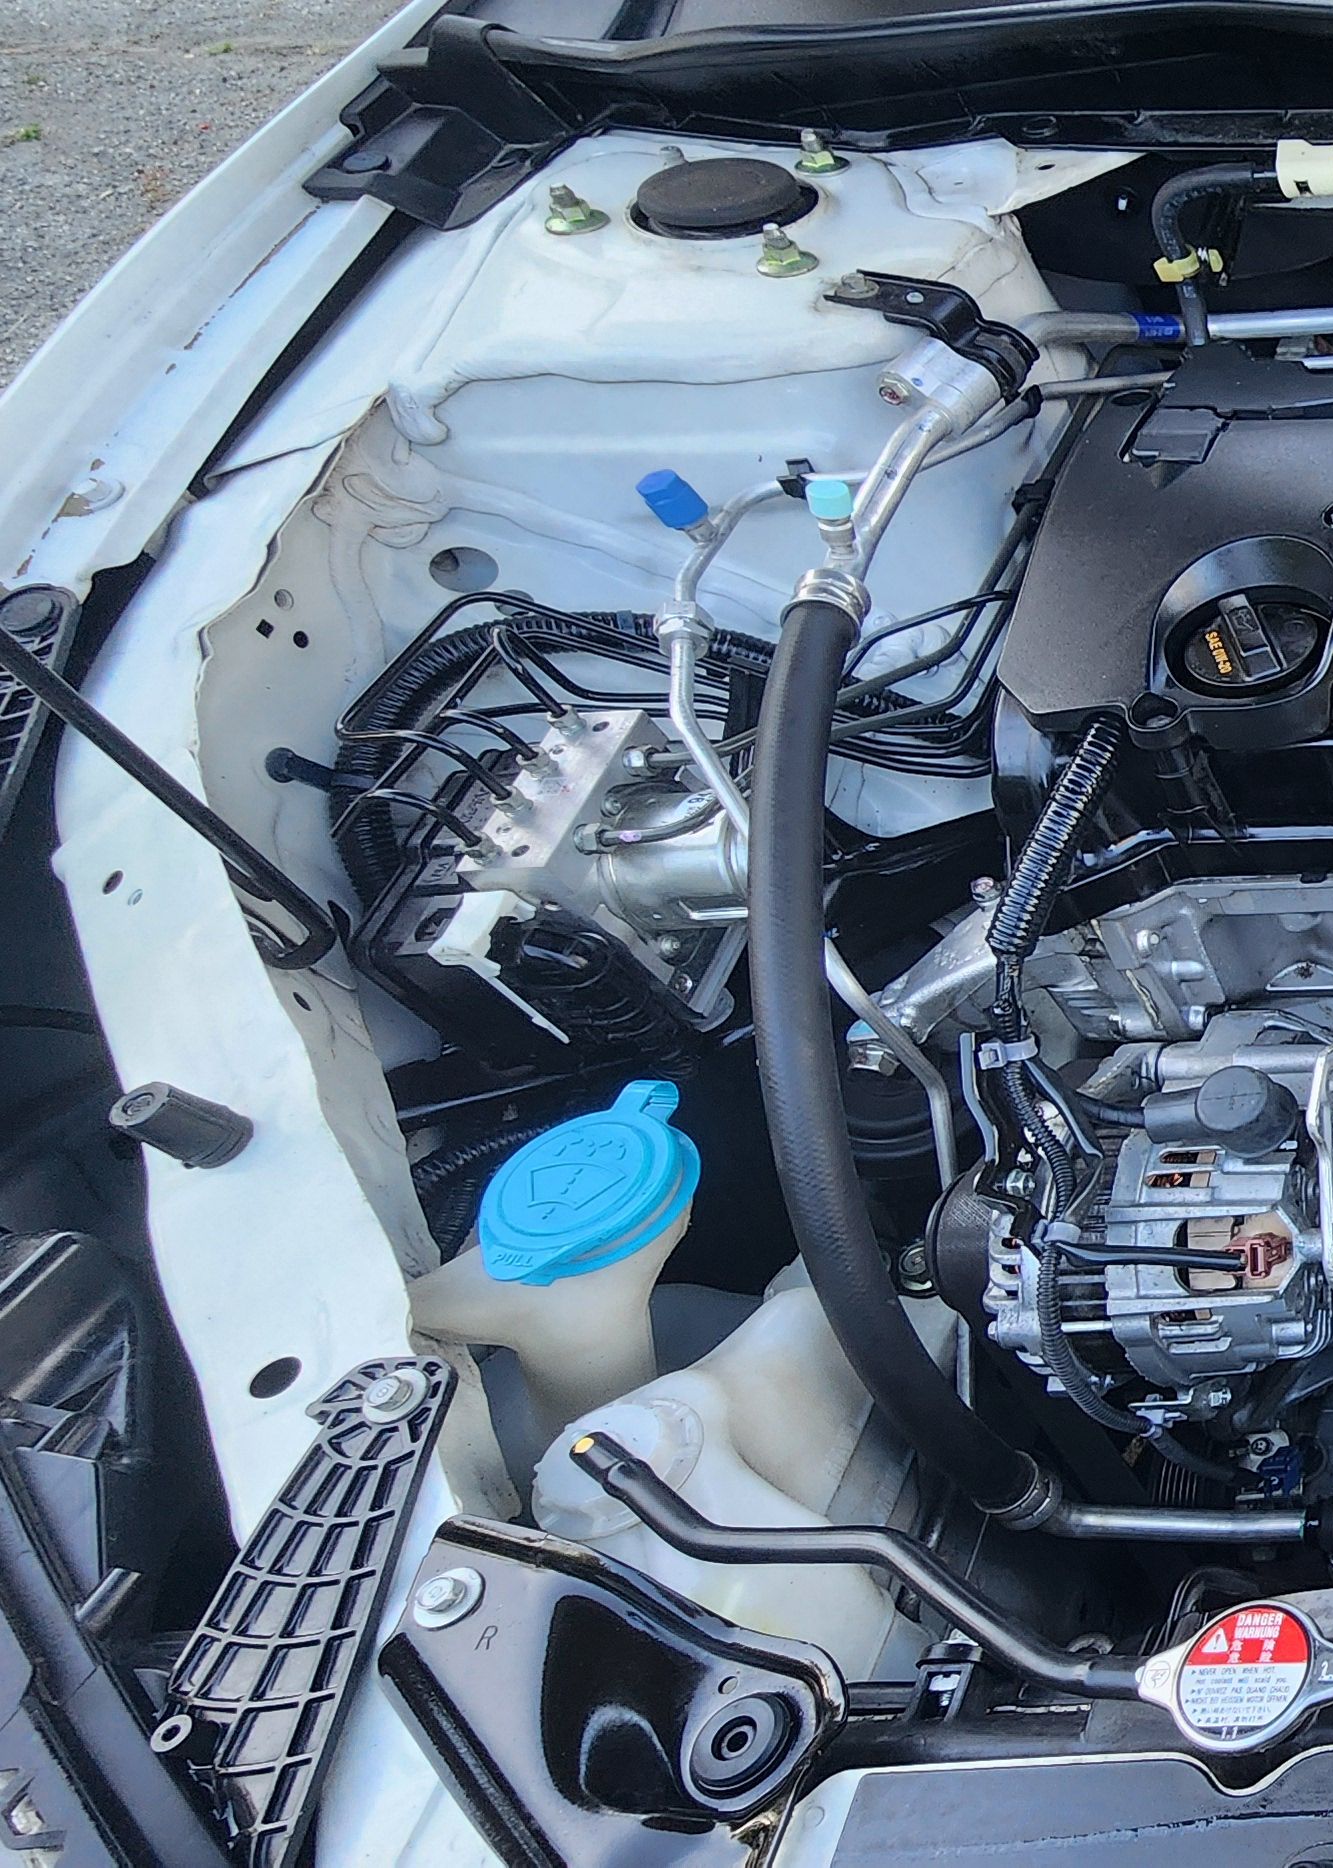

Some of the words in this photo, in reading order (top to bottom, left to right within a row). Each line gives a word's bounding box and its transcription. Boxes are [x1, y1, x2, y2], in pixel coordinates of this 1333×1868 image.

[1205, 632, 1222, 650] SAE
[1212, 648, 1232, 674] 0W-20
[490, 1253, 535, 1268] PULL
[1236, 1612, 1285, 1626] DANGER
[474, 1625, 498, 1651] R
[1234, 1626, 1281, 1639] WARNUNG
[1199, 1667, 1217, 1675] NEVER
[1221, 1667, 1236, 1675] OPEN
[1231, 1686, 1243, 1695] PAS
[1221, 1725, 1239, 1741] 1.1
